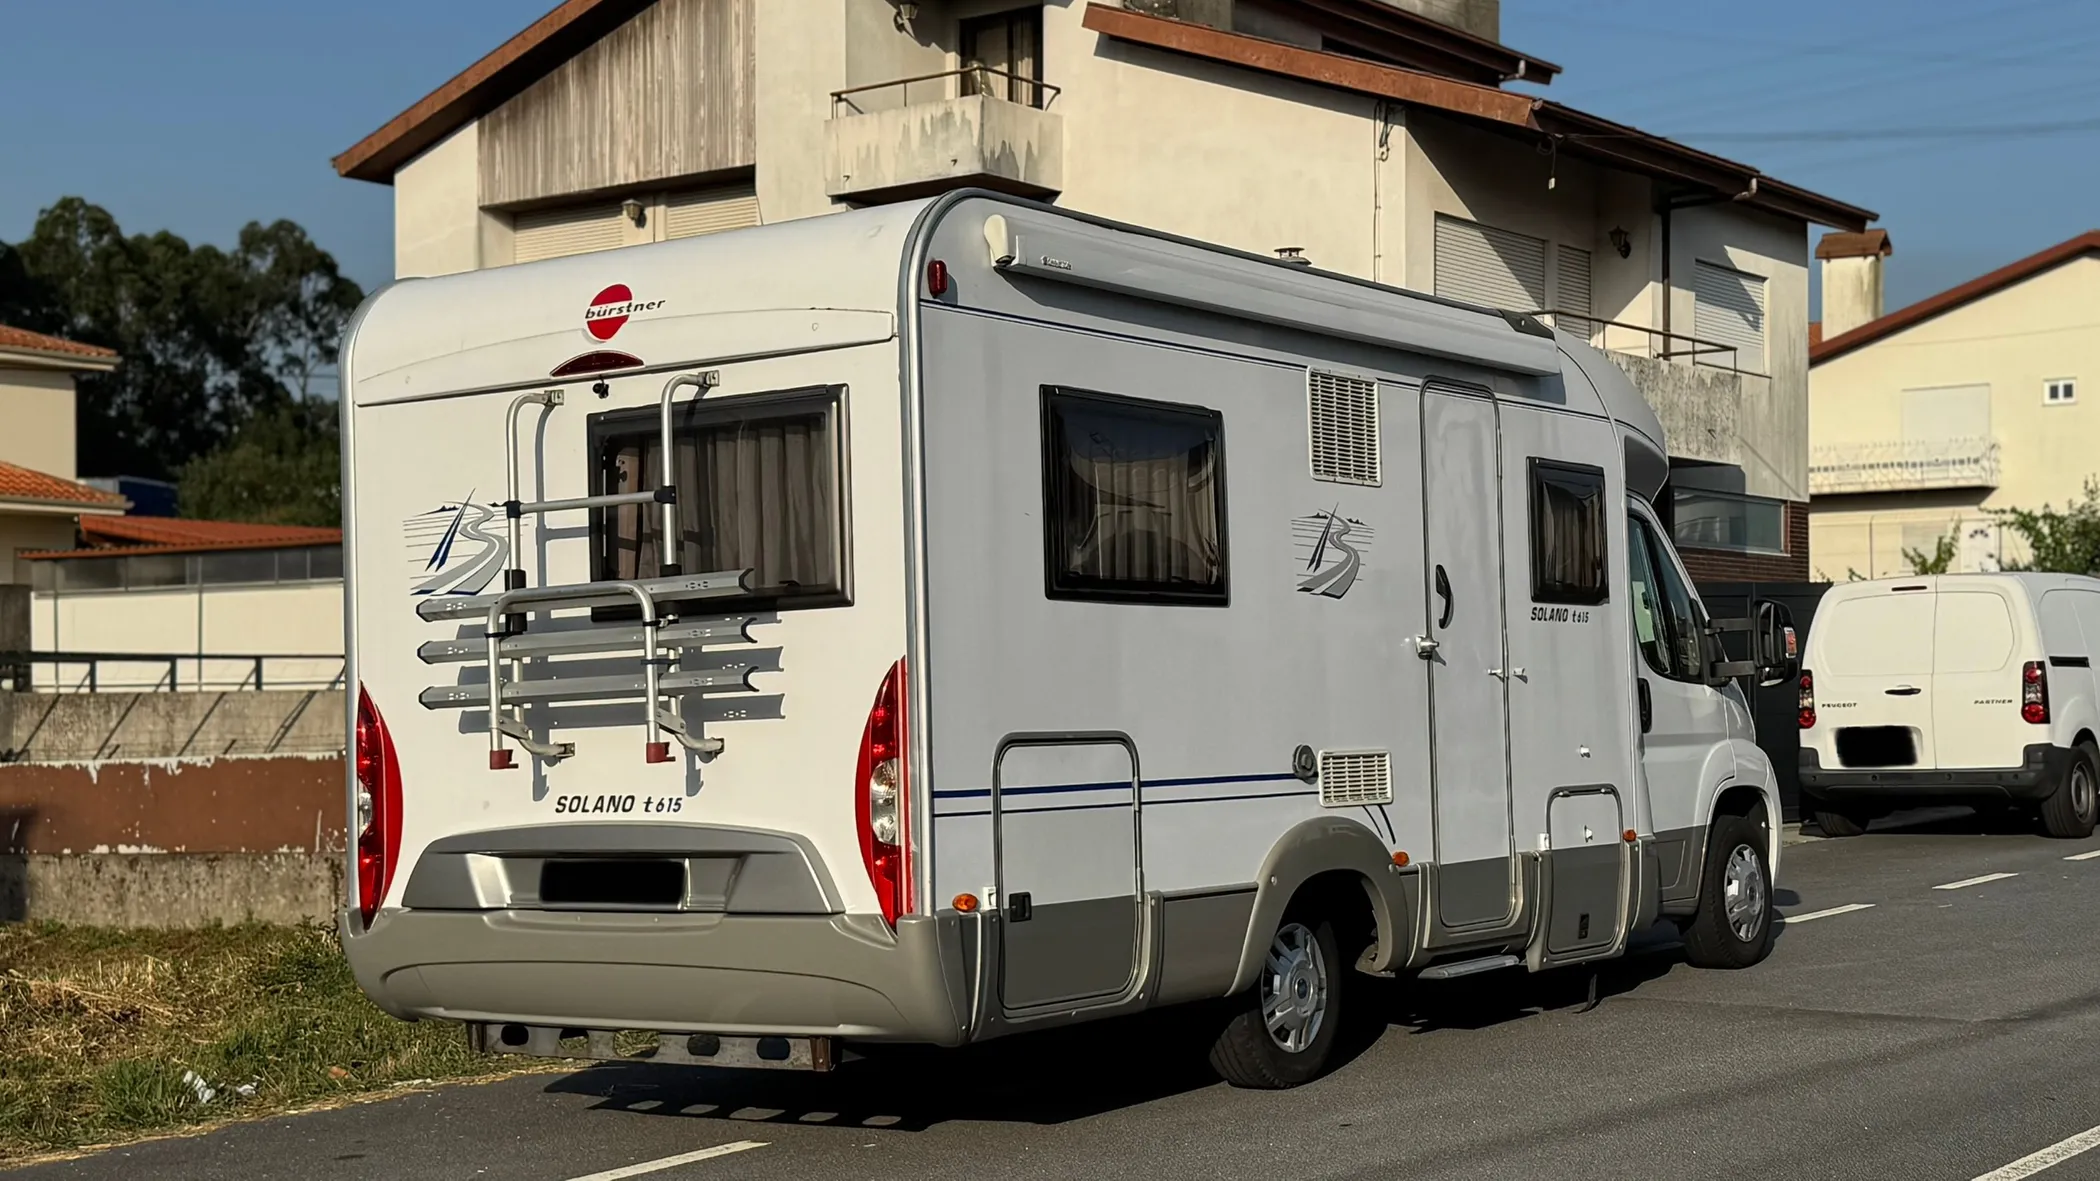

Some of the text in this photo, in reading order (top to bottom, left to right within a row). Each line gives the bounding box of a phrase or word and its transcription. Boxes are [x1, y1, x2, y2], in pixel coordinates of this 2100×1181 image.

[585, 299, 666, 319] bürstner
[1530, 606, 1569, 622] SOLANO
[555, 794, 683, 813] SOLANO t615
